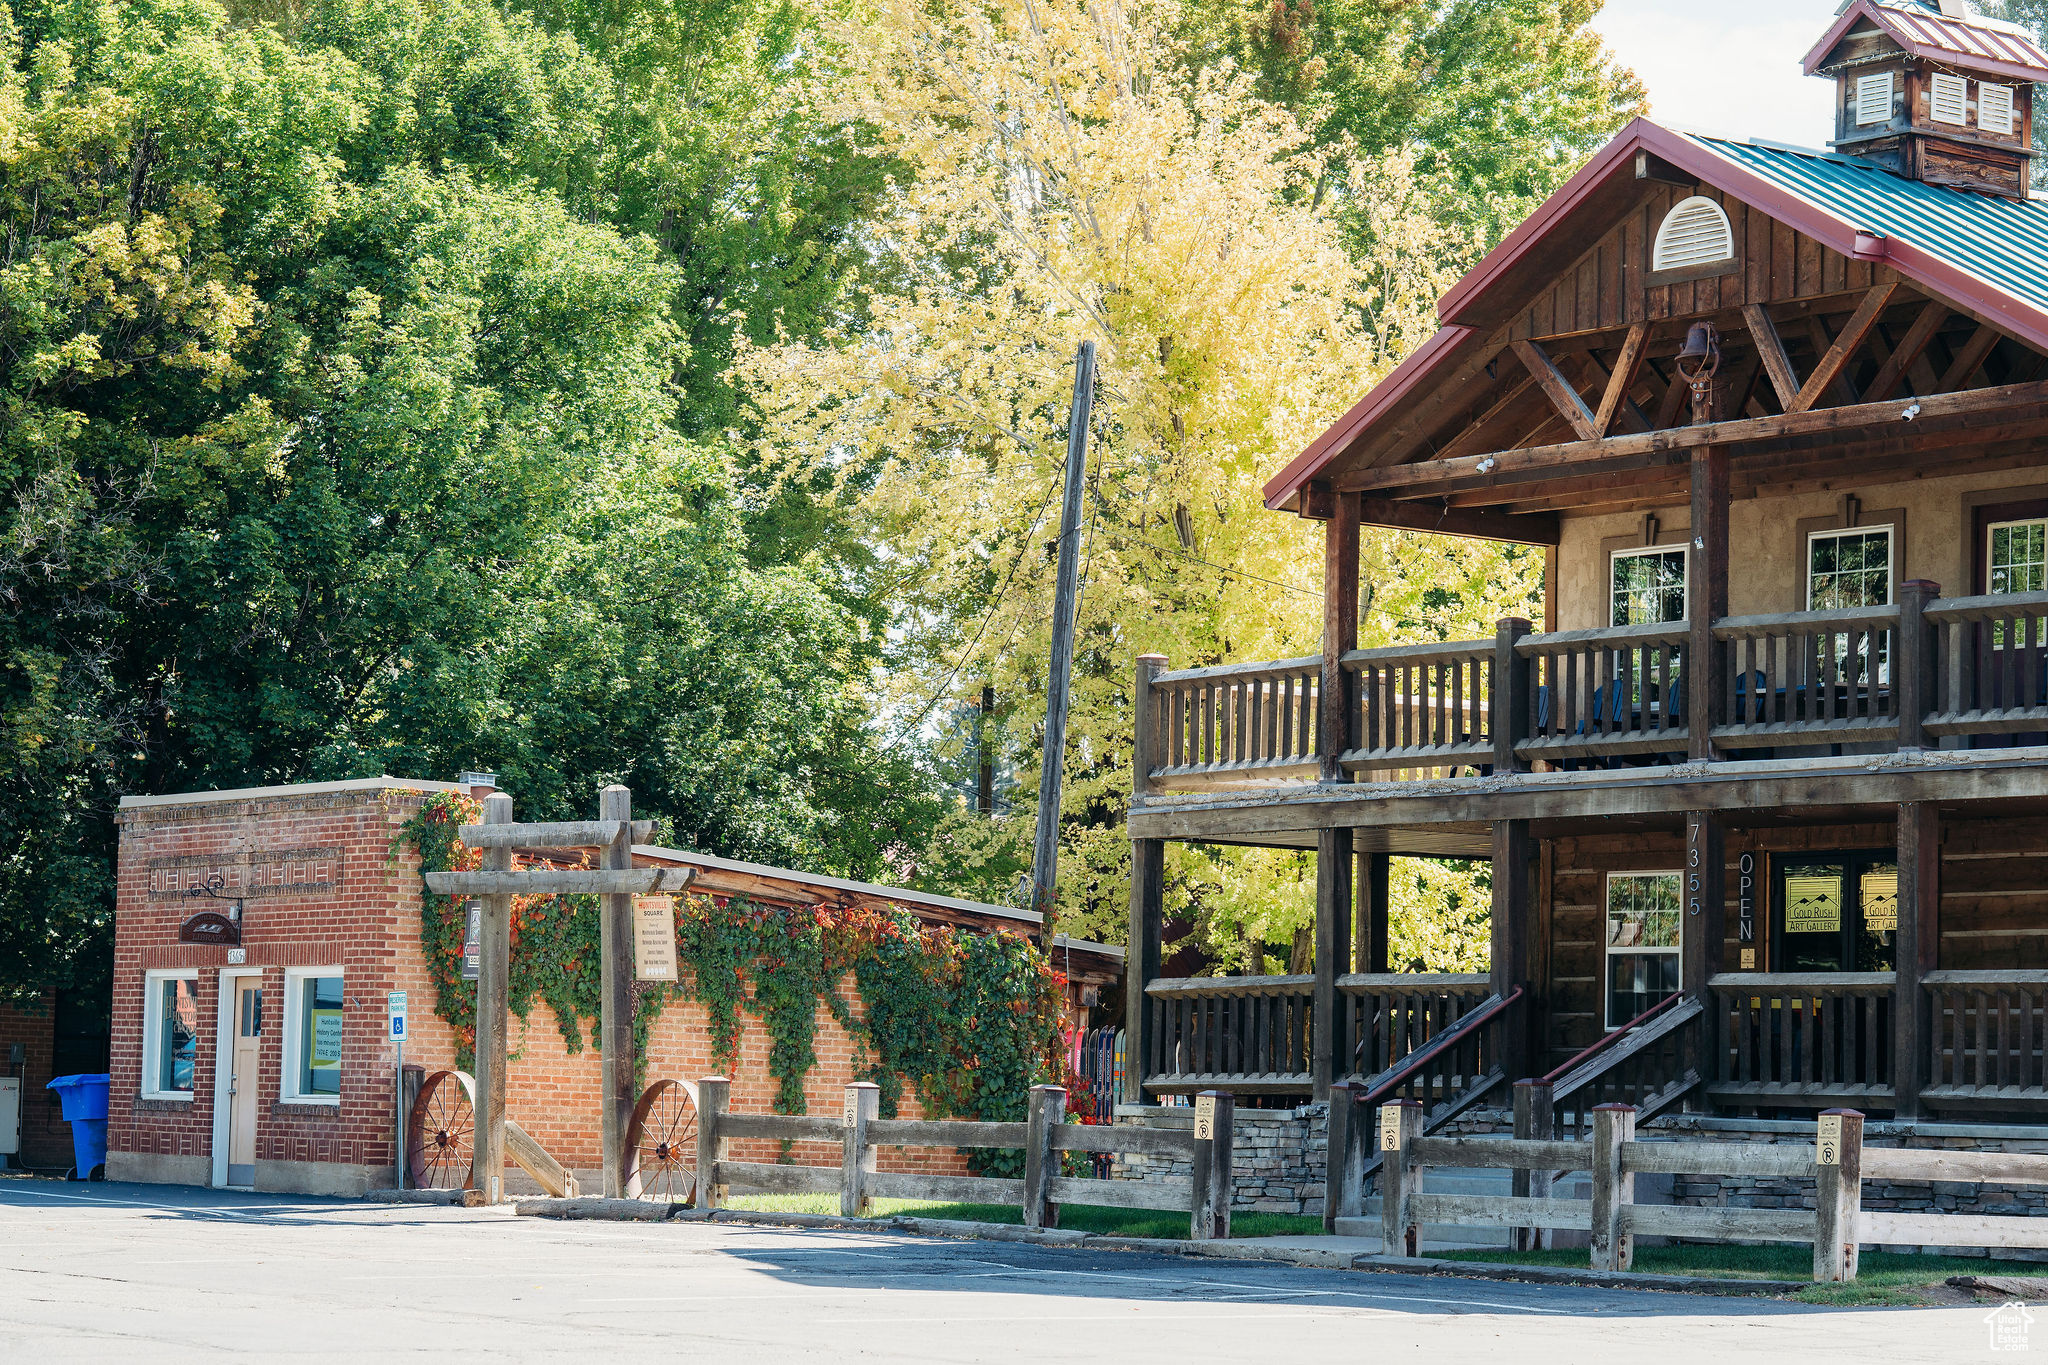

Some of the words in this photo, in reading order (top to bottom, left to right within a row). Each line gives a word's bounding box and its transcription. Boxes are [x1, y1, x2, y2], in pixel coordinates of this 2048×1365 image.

[1690, 824, 1700, 916] 7355
[1740, 854, 1753, 940] OPEN
[638, 901, 667, 909] HUNTSVILLE
[1869, 905, 1888, 916] GOLD
[1794, 907, 1812, 919] GOLD
[1814, 907, 1833, 918] RUSH
[1790, 921, 1804, 931] ART
[1806, 919, 1837, 932] GALLERY
[1867, 919, 1880, 929] ART
[192, 933, 226, 941] LIBRARY
[317, 1029, 329, 1037] History
